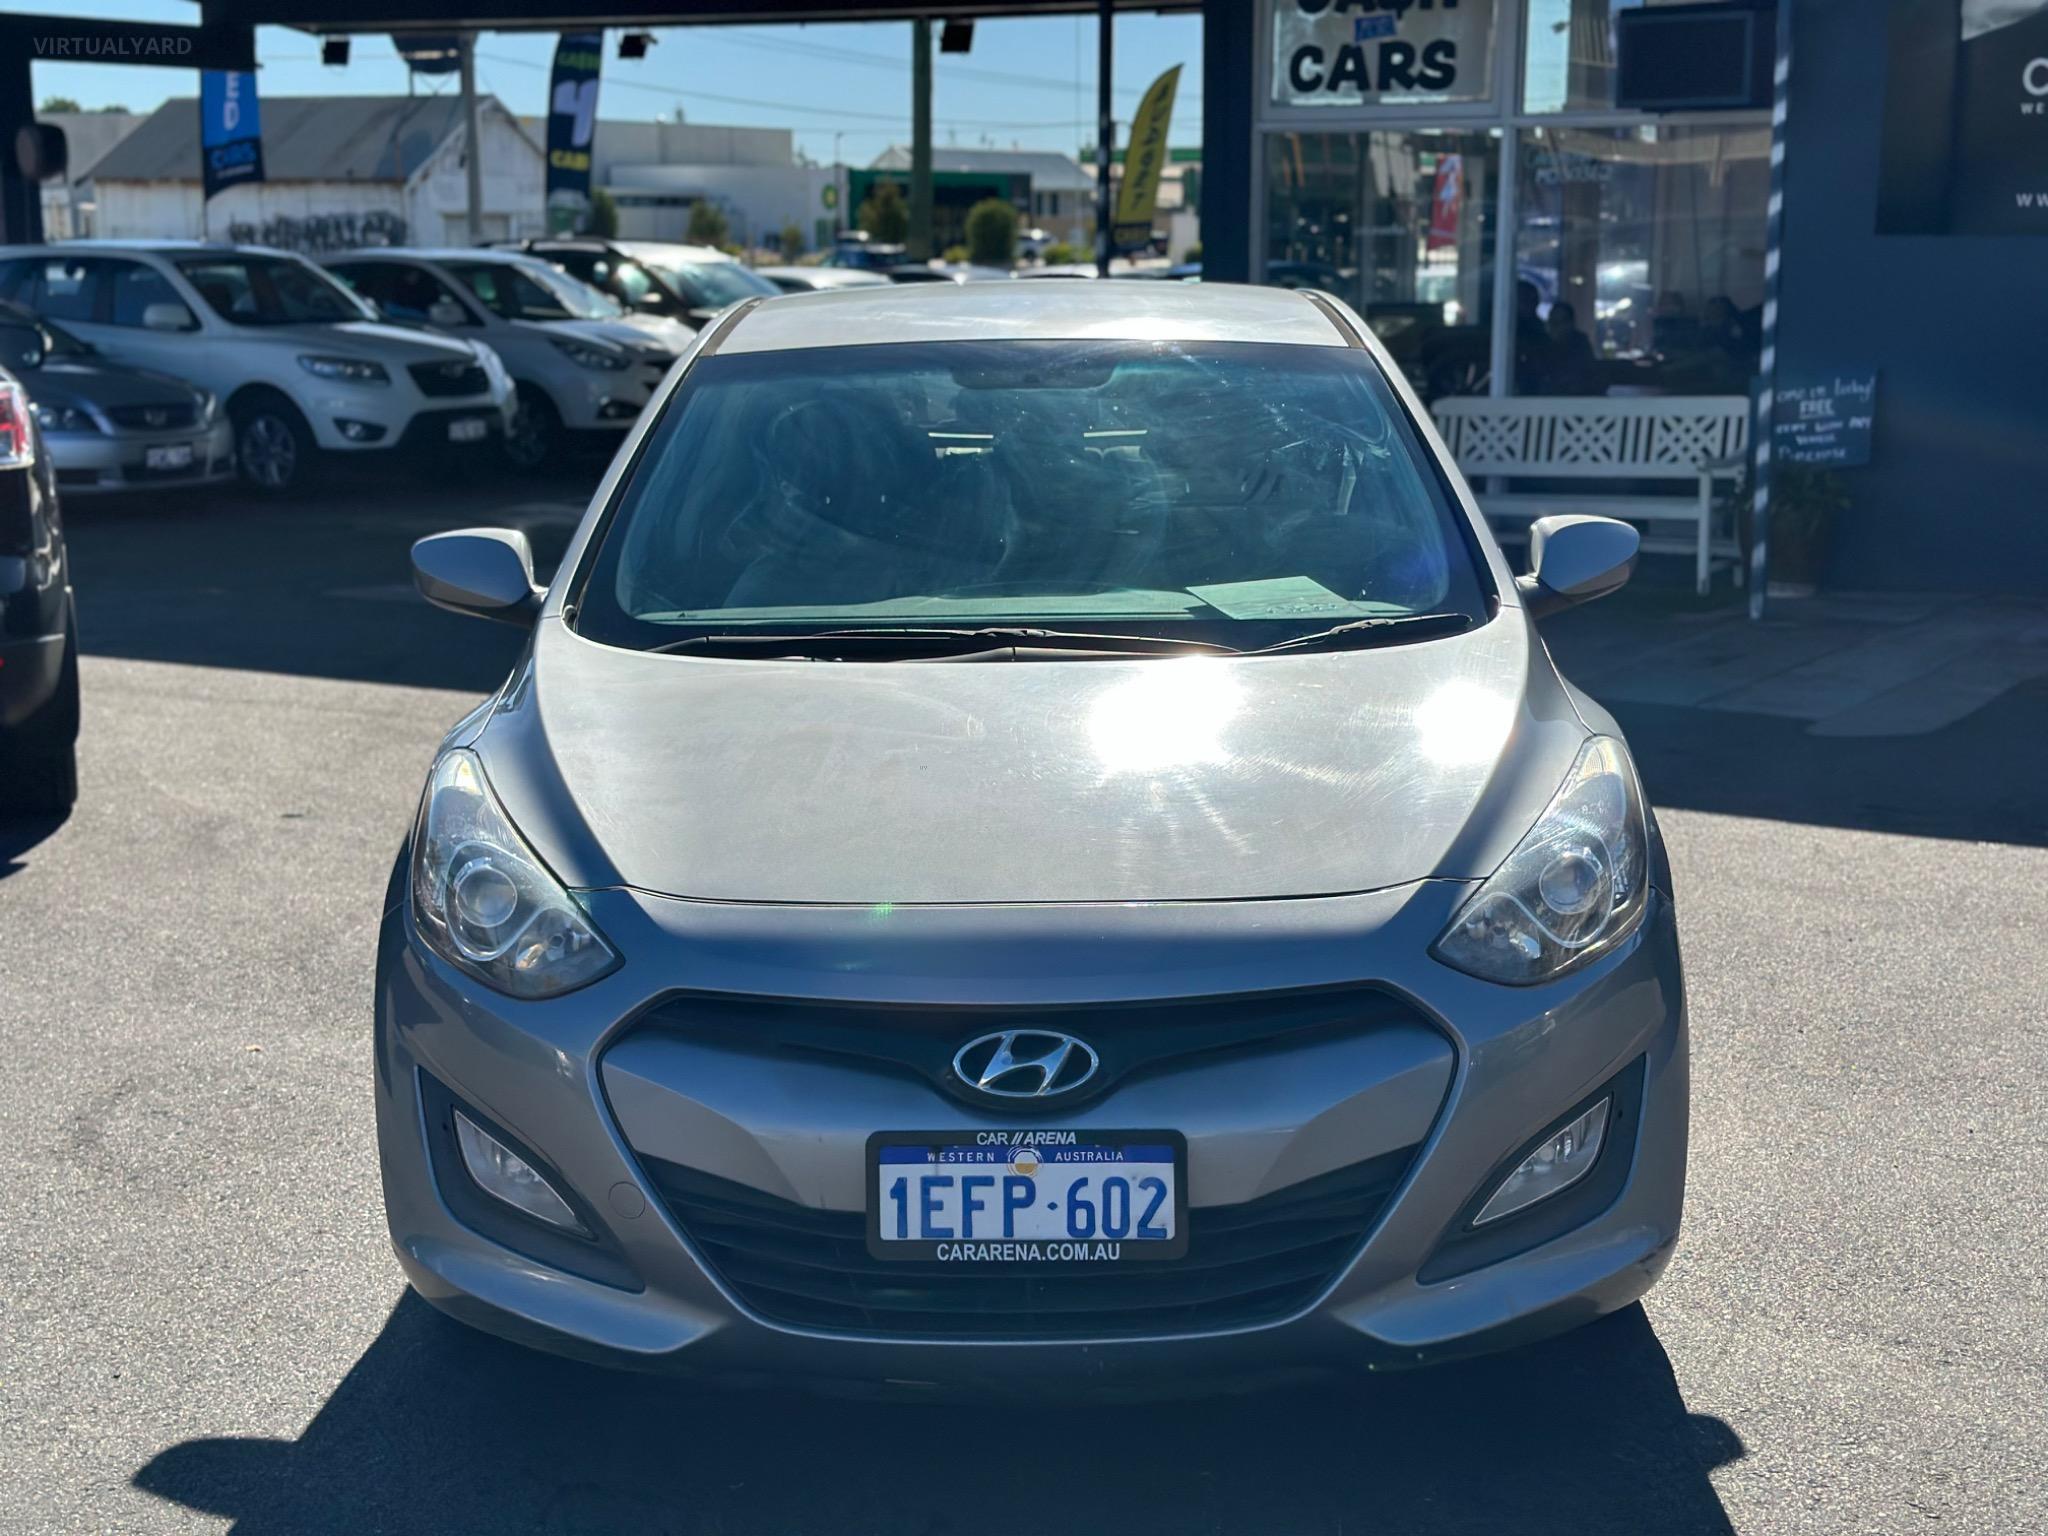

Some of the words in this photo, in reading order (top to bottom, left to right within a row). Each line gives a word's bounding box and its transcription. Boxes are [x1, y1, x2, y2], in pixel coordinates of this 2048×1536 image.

[1289, 39, 1456, 93] CARS
[2020, 102, 2045, 115] WE
[927, 1152, 995, 1162] WESTERN
[1055, 1151, 1124, 1162] AUSTRALIA
[937, 1243, 1121, 1262] CARARENA.COM.AU
